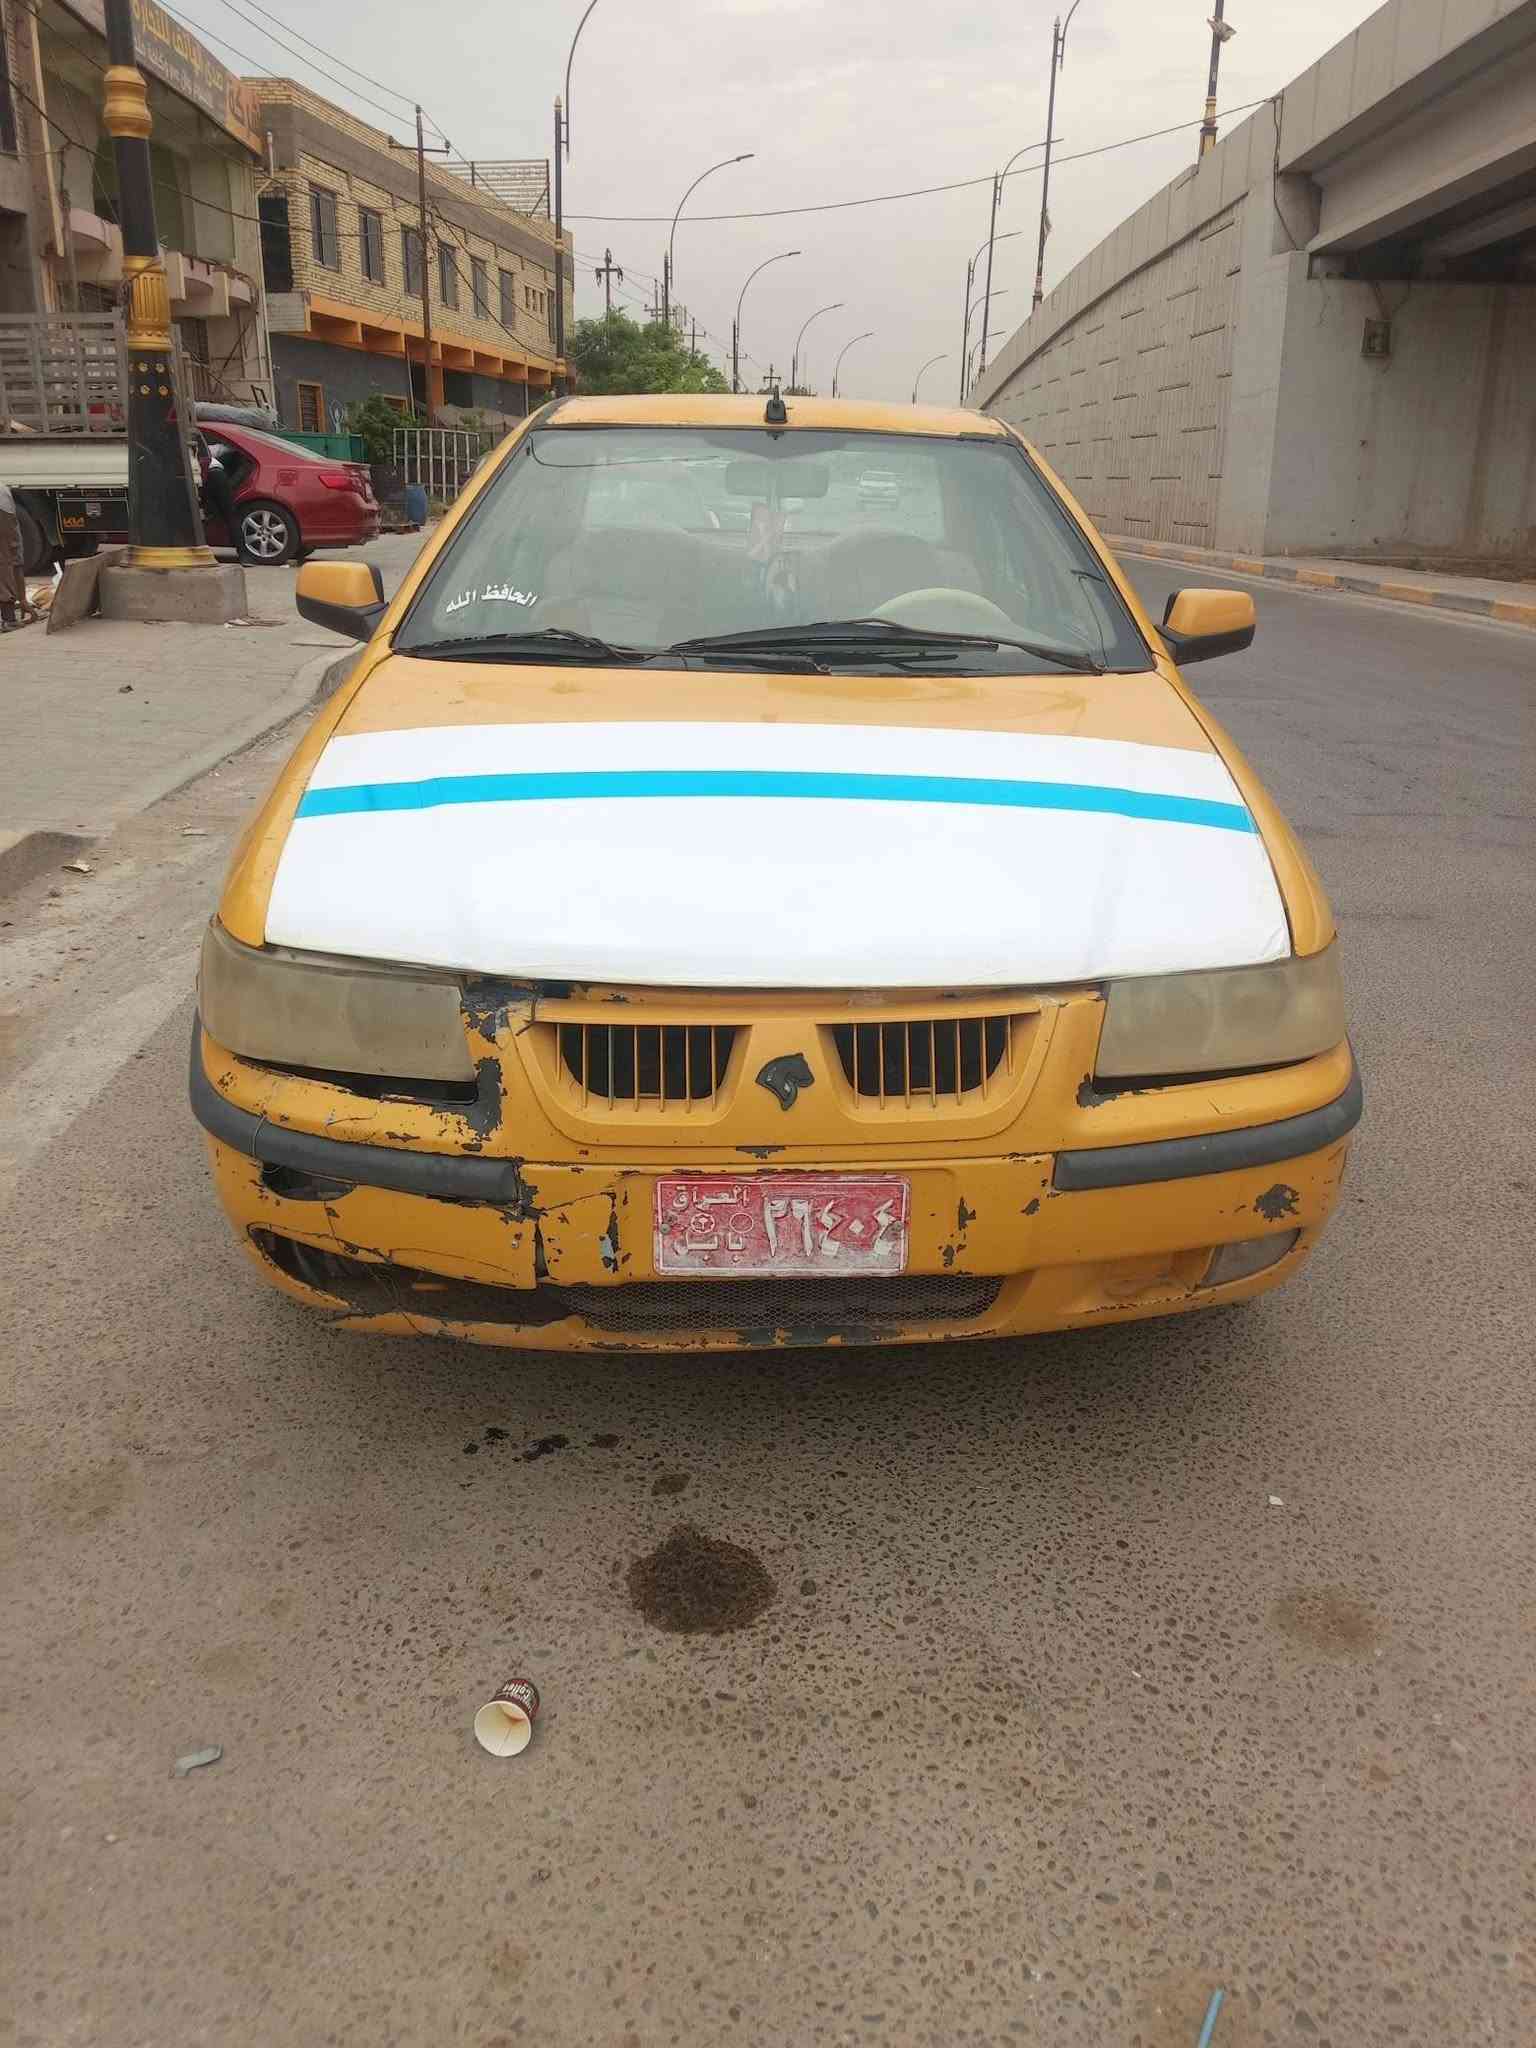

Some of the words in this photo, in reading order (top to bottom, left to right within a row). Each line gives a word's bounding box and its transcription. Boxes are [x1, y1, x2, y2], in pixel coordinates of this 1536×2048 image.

[446, 588, 477, 613] الله
[481, 583, 538, 607] الحافظ
[673, 1185, 751, 1211] العراق
